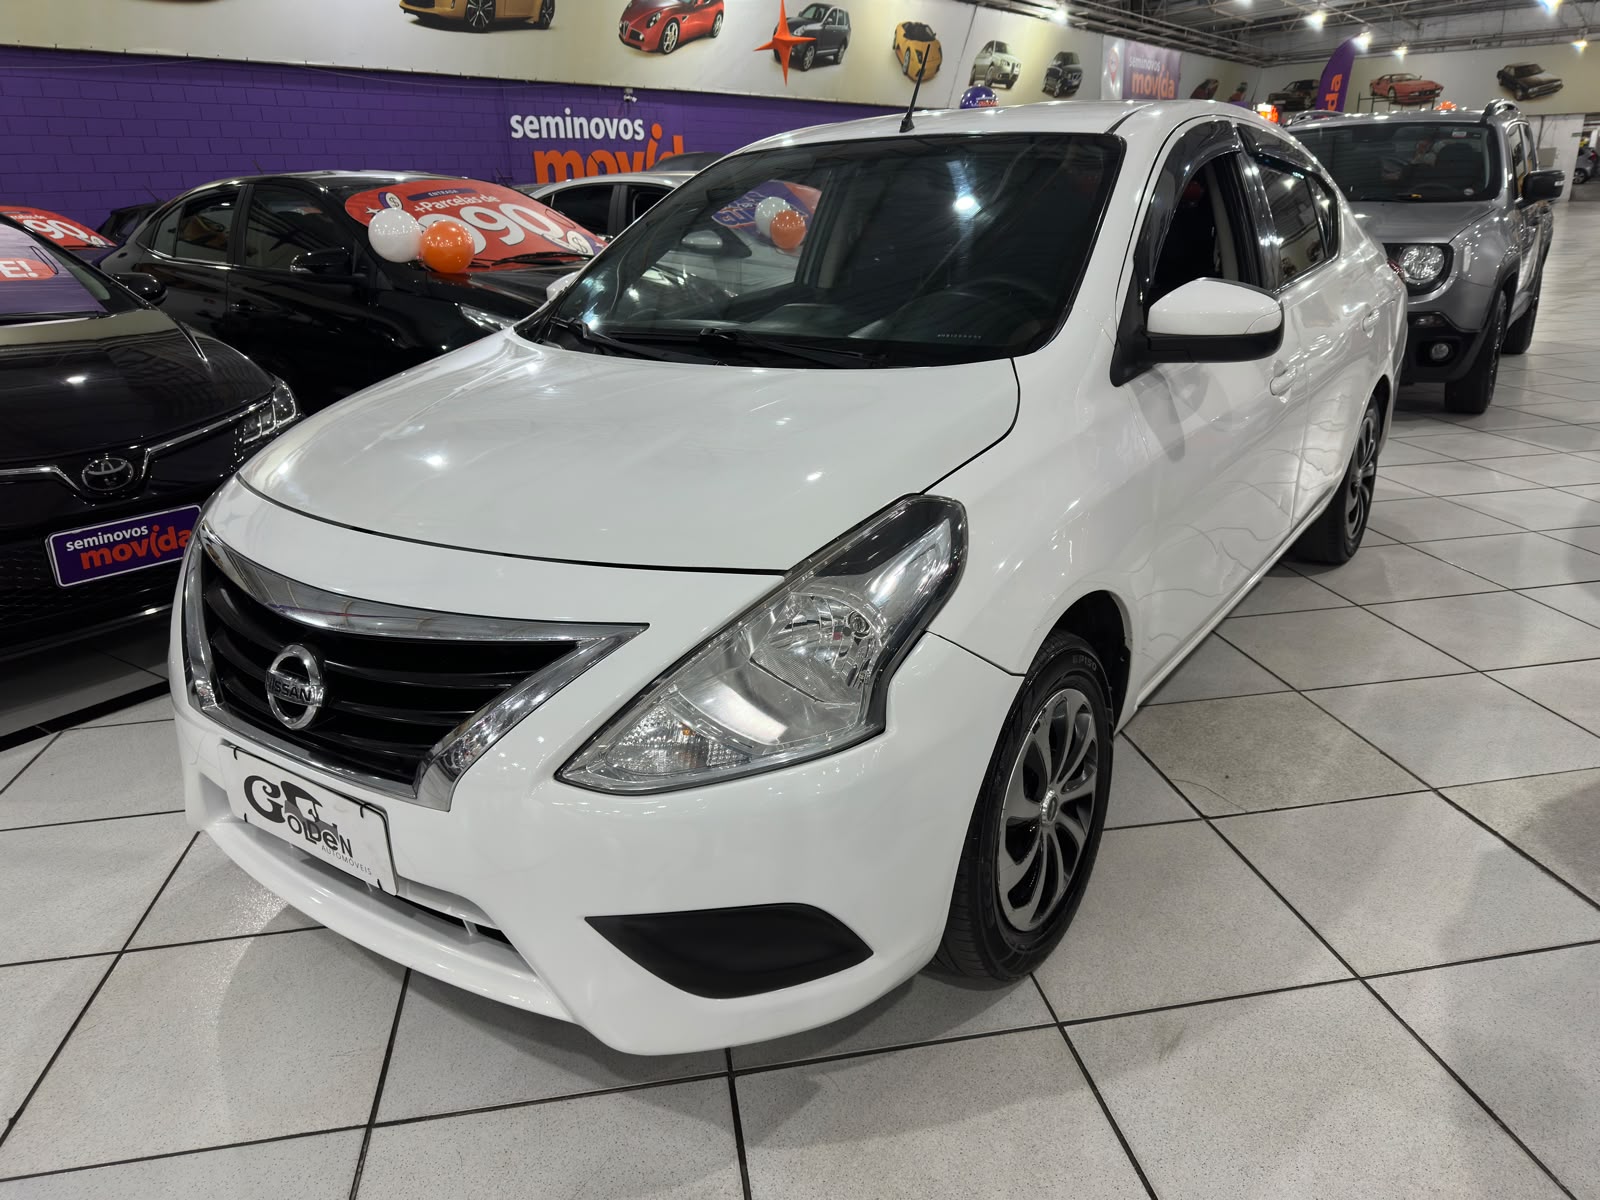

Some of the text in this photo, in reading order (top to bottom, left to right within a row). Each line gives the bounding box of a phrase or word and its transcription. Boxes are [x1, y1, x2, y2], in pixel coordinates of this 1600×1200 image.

[1129, 56, 1161, 73] seminovos
[1131, 63, 1175, 100] movida
[510, 107, 645, 141] seminovos
[66, 525, 149, 552] seminovos
[80, 524, 192, 570] movida
